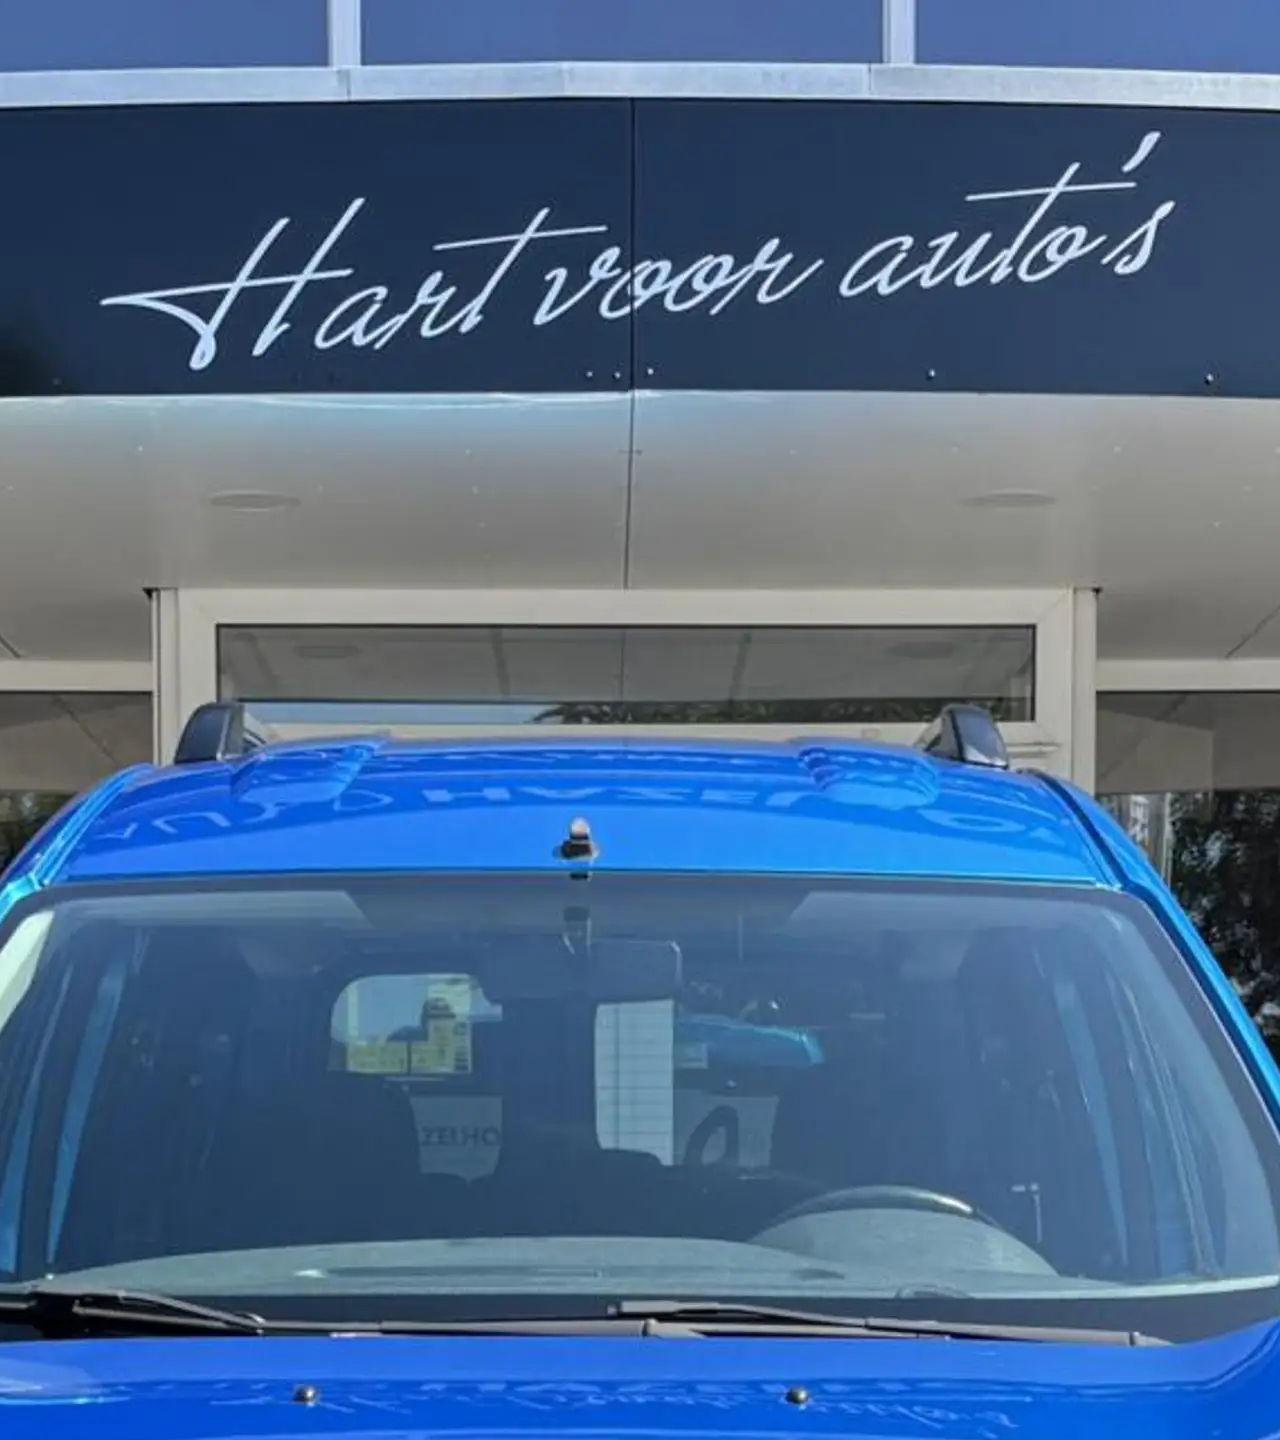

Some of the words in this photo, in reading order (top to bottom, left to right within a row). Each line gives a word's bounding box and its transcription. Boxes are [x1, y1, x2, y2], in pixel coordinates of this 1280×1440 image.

[101, 198, 607, 370] Hart
[533, 234, 824, 326] voor
[839, 131, 1175, 297] auto's
